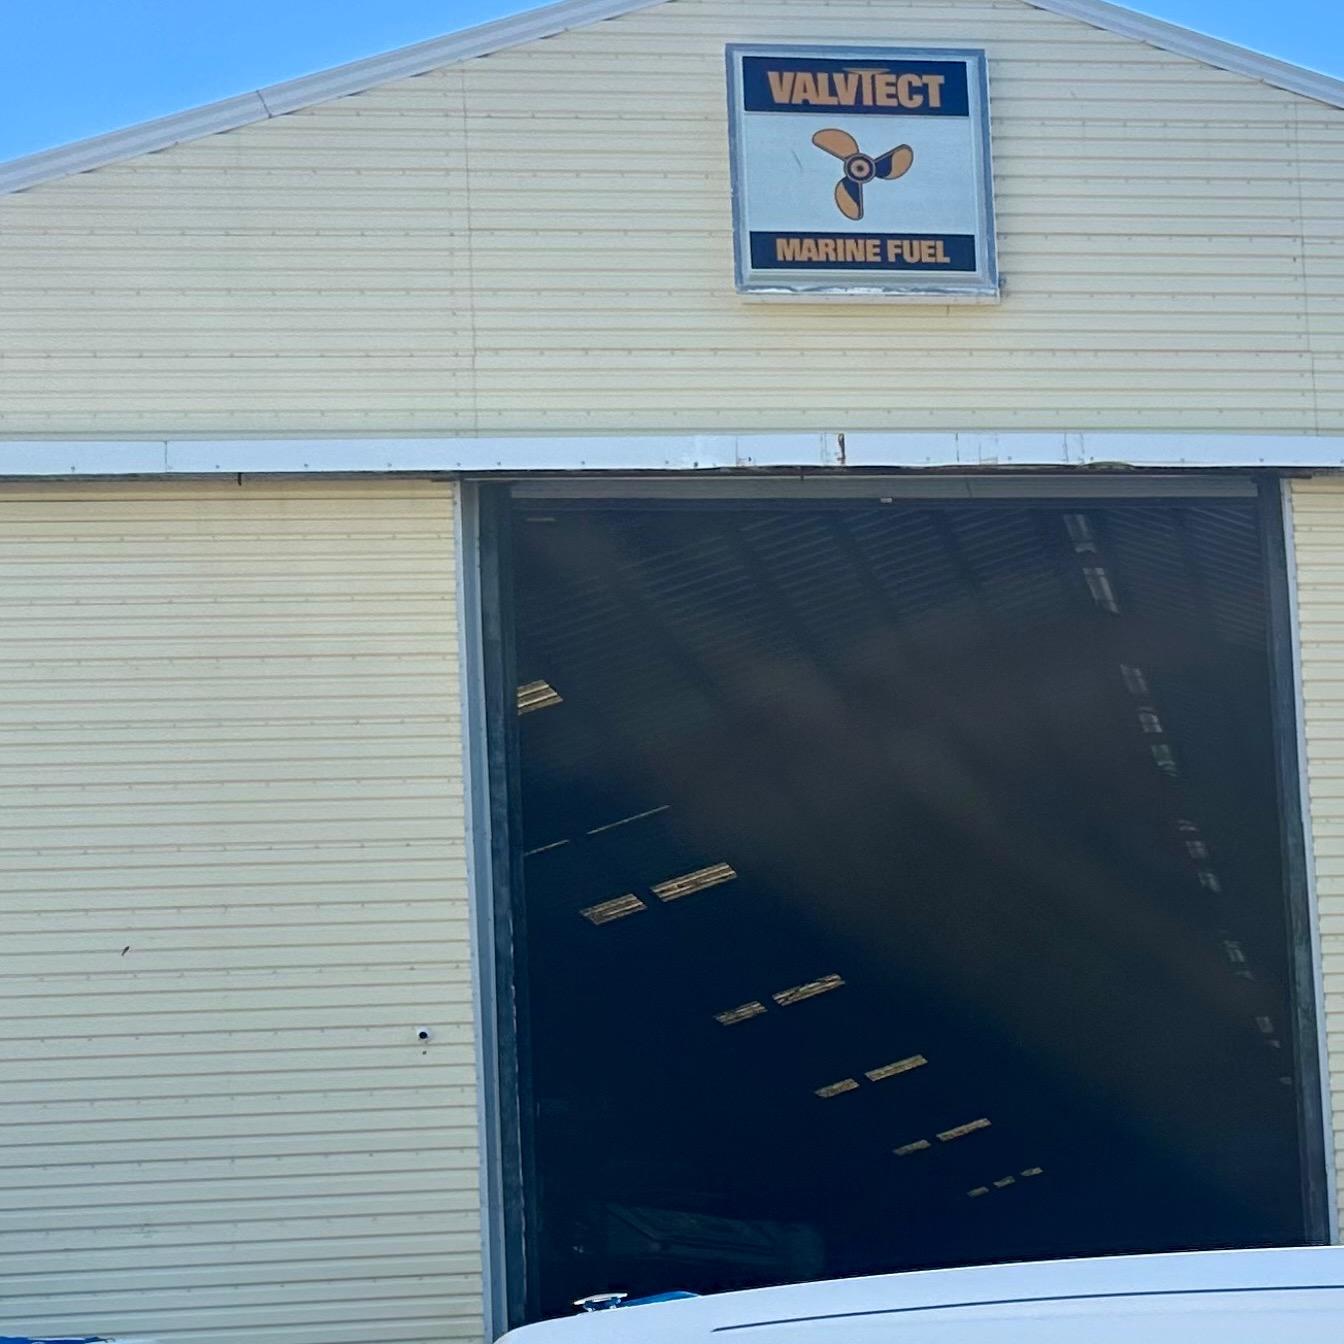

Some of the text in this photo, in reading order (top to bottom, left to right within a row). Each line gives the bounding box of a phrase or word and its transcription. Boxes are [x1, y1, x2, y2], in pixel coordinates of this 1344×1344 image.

[767, 67, 945, 109] VALVTECT
[776, 238, 951, 263] MARINE FUEL
